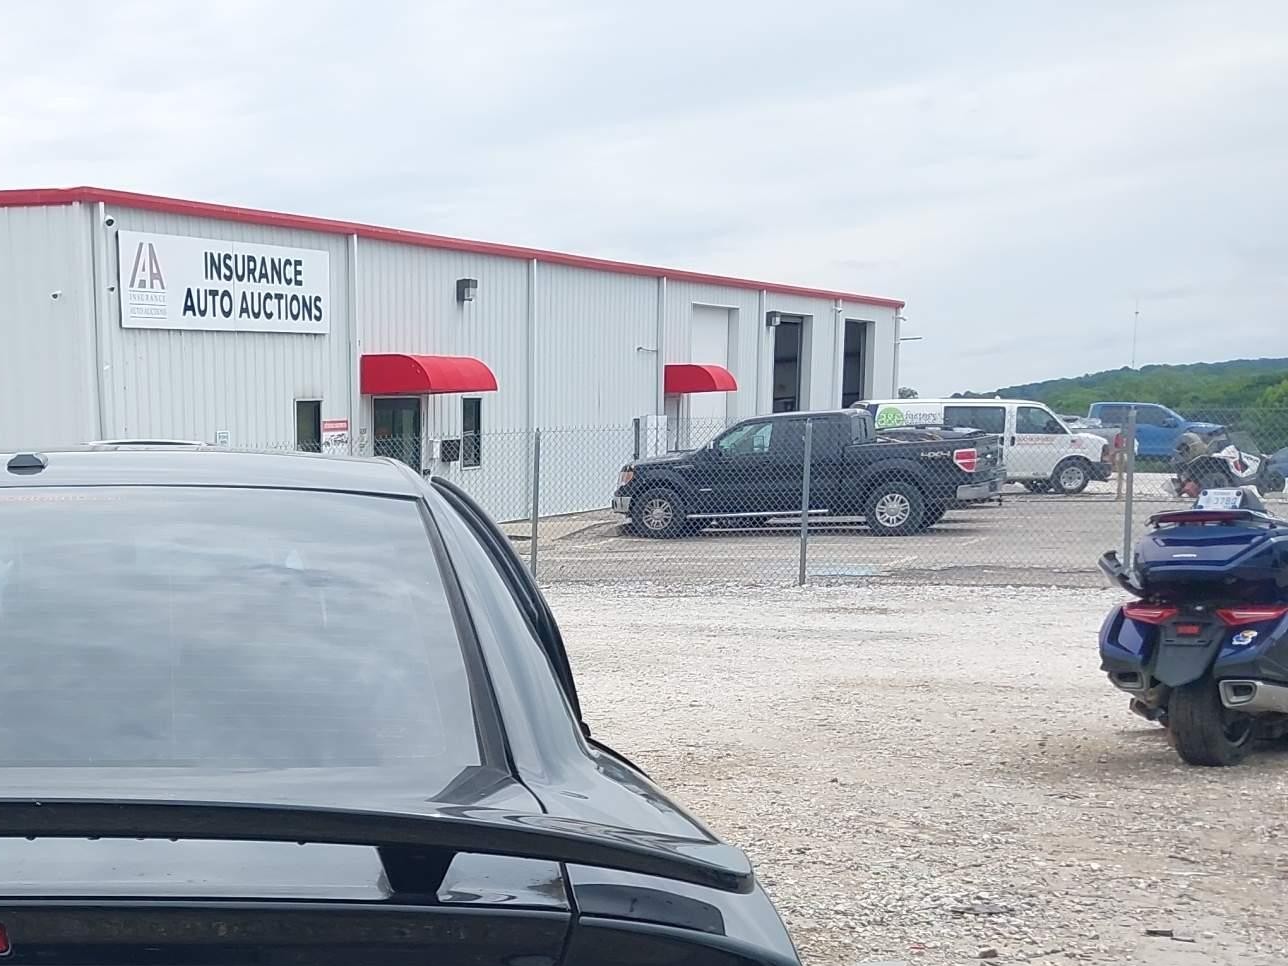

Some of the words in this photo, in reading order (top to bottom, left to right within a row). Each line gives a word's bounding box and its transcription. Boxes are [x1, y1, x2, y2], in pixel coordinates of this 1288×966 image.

[204, 251, 304, 287] INSURANCE
[182, 287, 233, 318] AUTO
[239, 291, 323, 322] AUCTIONS
